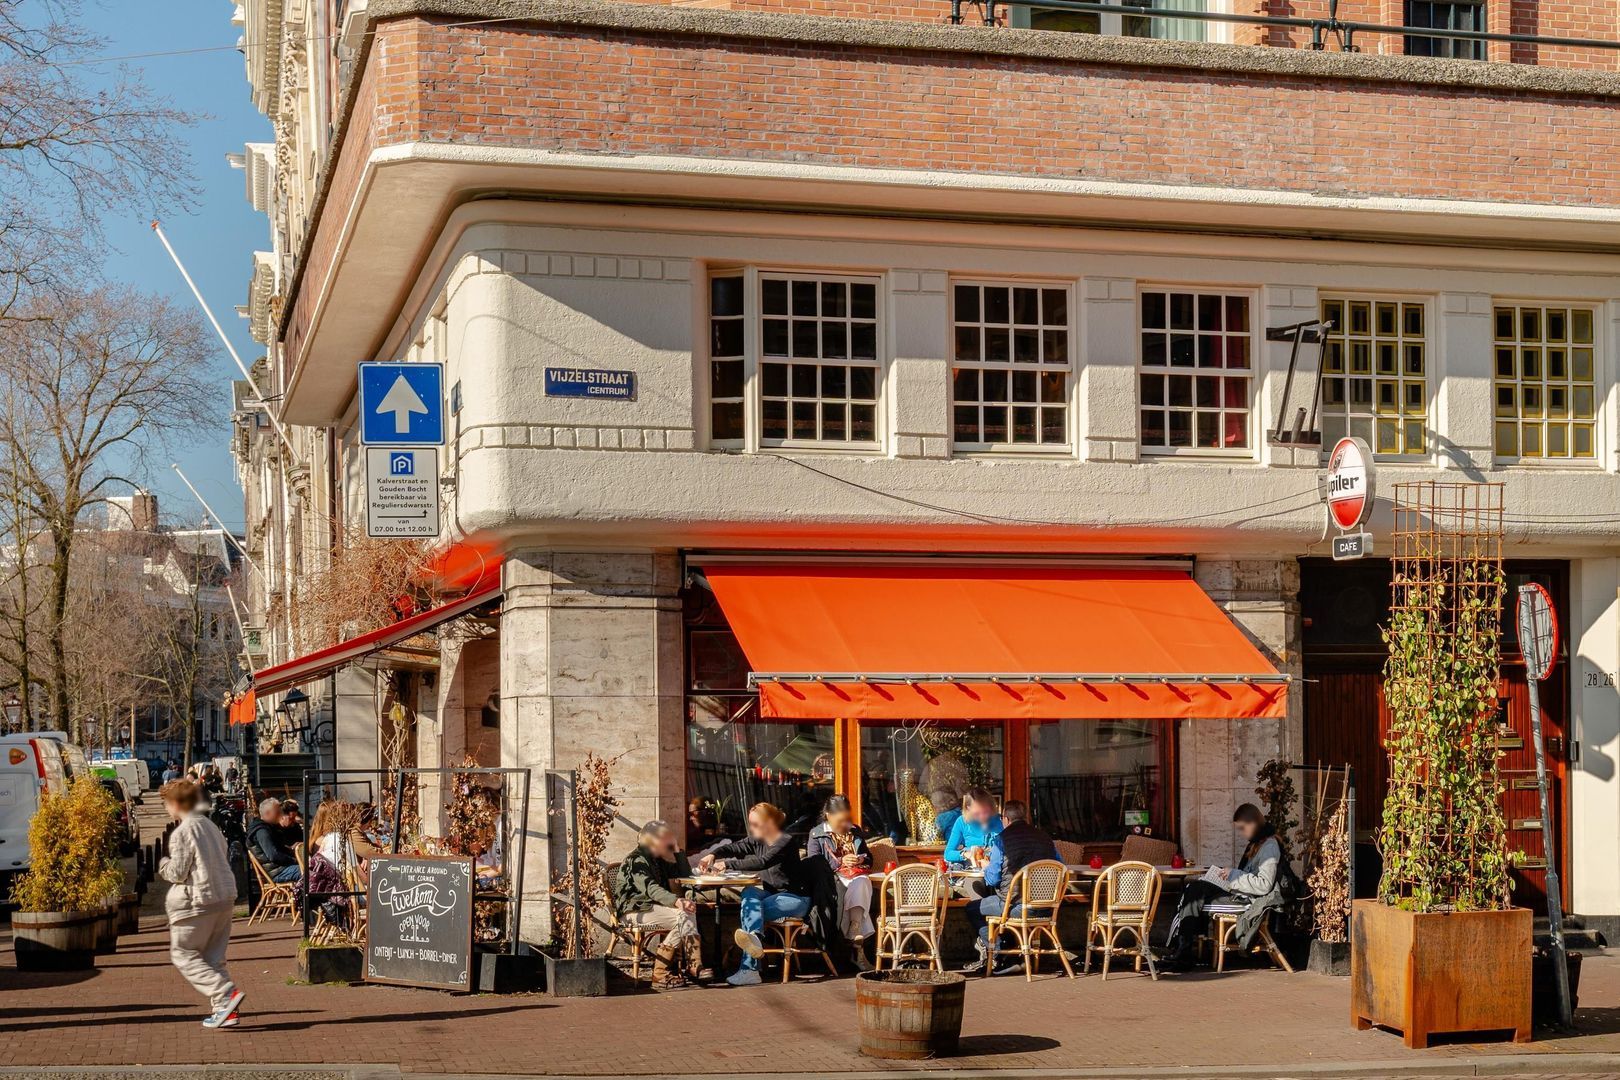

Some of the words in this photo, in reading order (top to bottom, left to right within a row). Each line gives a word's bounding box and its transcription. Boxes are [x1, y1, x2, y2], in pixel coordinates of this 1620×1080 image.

[549, 370, 629, 385] VIJZELSTRAAT
[587, 386, 629, 396] (CENTRUM)
[372, 502, 435, 510] Reguliersdwarsstr.
[1339, 542, 1358, 553] CAFE
[1587, 673, 1598, 686] 28
[1603, 673, 1614, 686] 26
[400, 865, 426, 874] ENTRANCE
[427, 867, 448, 875] AROUND
[392, 887, 434, 911] Welkom
[399, 914, 414, 933] OPEN
[414, 914, 430, 932] VOOR
[397, 947, 415, 959] LUNCH
[419, 948, 440, 962] BORREL
[442, 951, 458, 964] DINER
